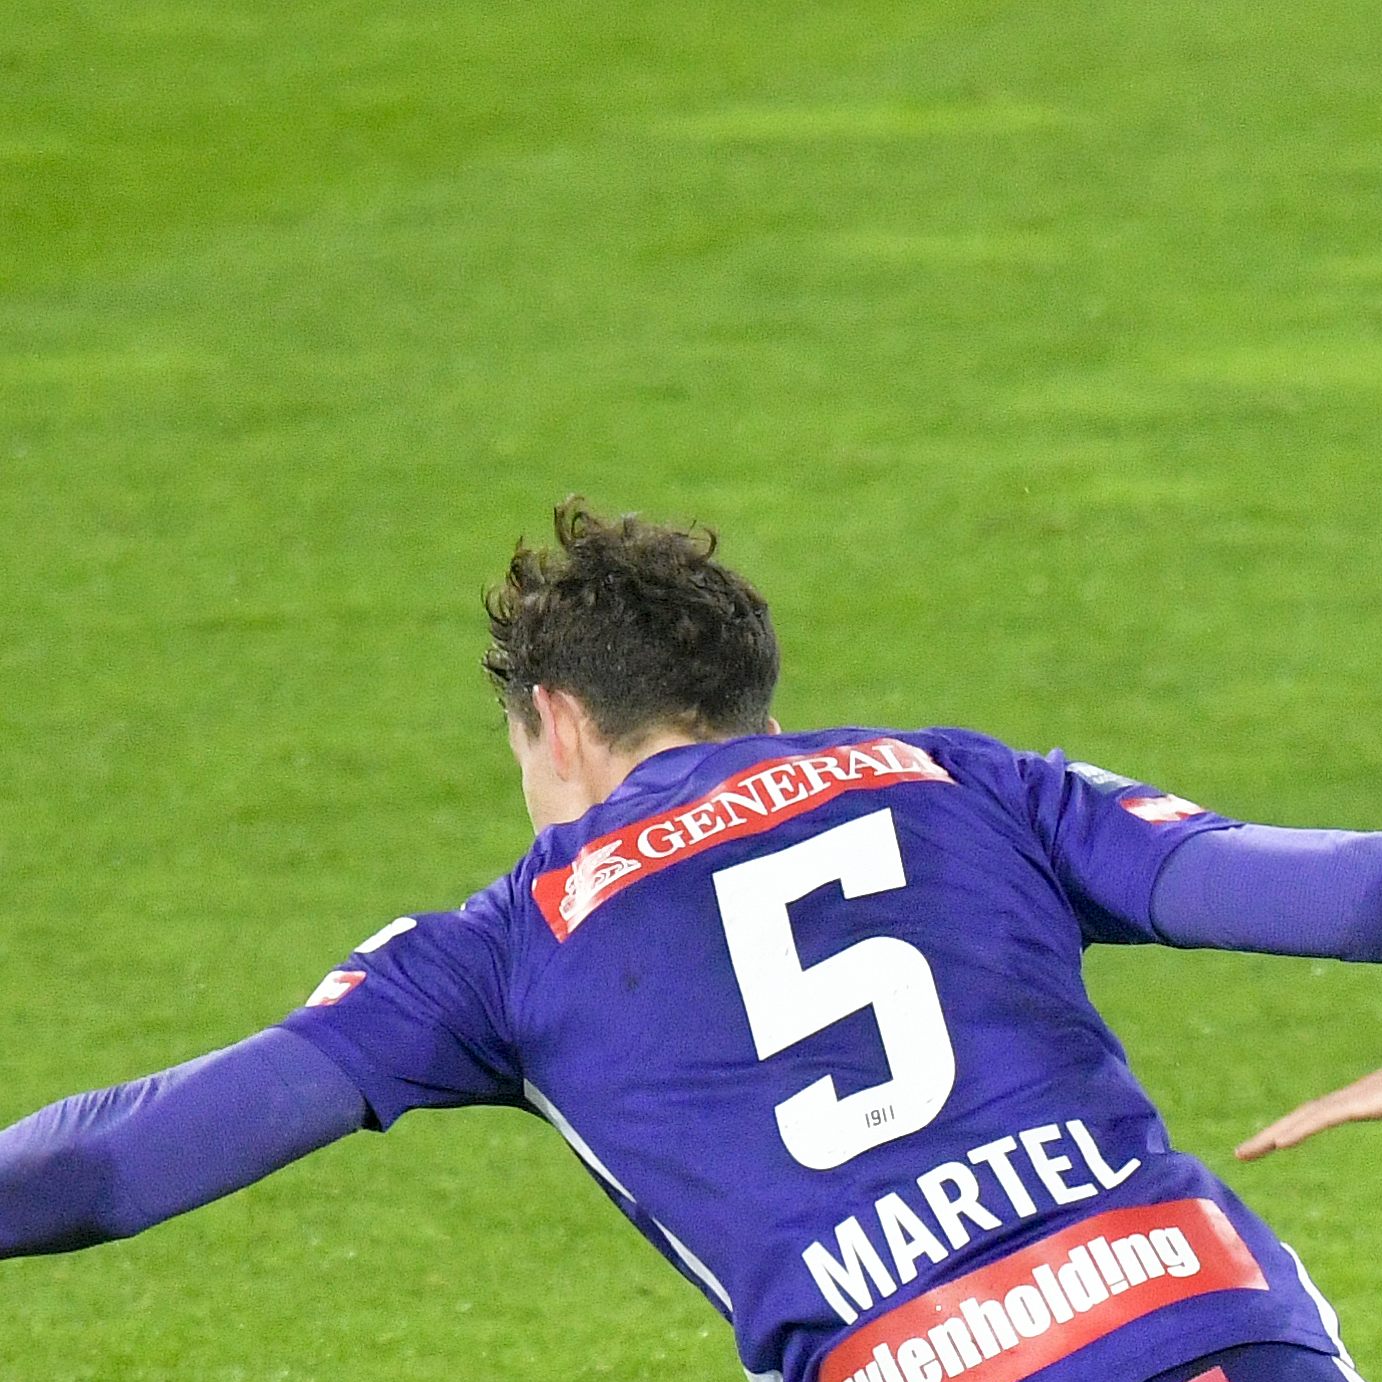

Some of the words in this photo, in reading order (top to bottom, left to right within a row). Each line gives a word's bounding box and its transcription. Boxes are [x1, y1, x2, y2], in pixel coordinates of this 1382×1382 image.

[712, 807, 956, 1170] 5
[864, 1104, 895, 1128] 1911
[801, 1117, 1142, 1326] MARTEL
